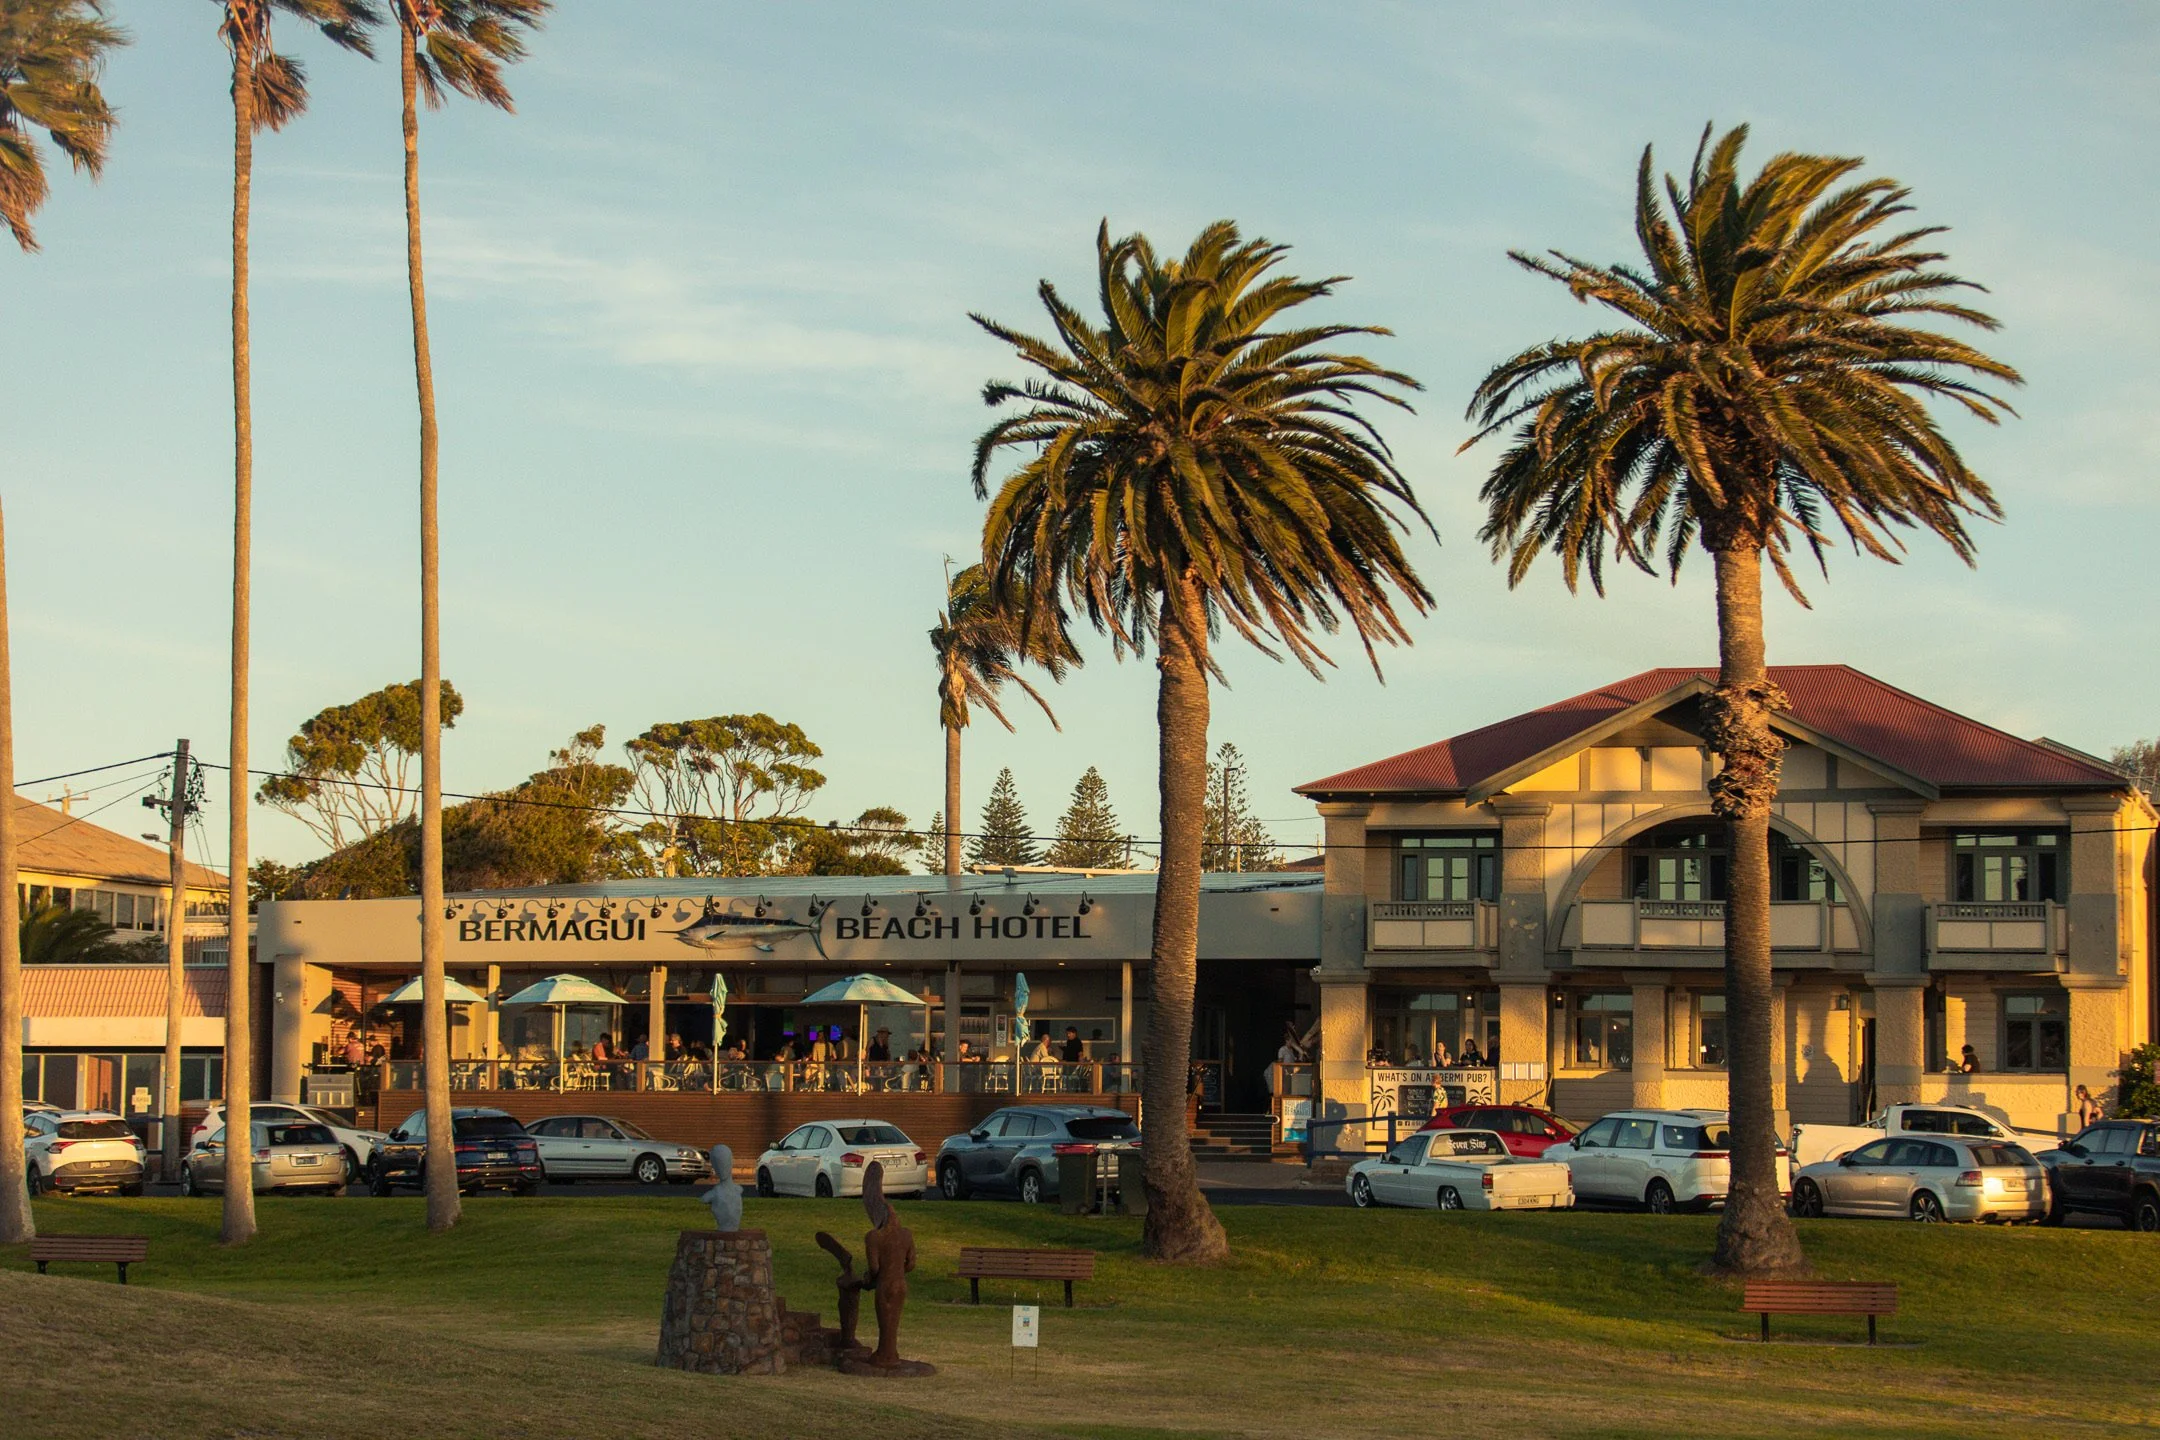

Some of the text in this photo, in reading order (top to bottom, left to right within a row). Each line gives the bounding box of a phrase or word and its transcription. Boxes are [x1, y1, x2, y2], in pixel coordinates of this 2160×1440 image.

[459, 915, 1092, 942] BERMAGUI BEACH HOTEL
[1378, 1072, 1408, 1083] WHAT'S
[1411, 1072, 1422, 1083] ON
[1467, 1073, 1488, 1083] PUB?
[1447, 1138, 1487, 1150] Seven Sins
